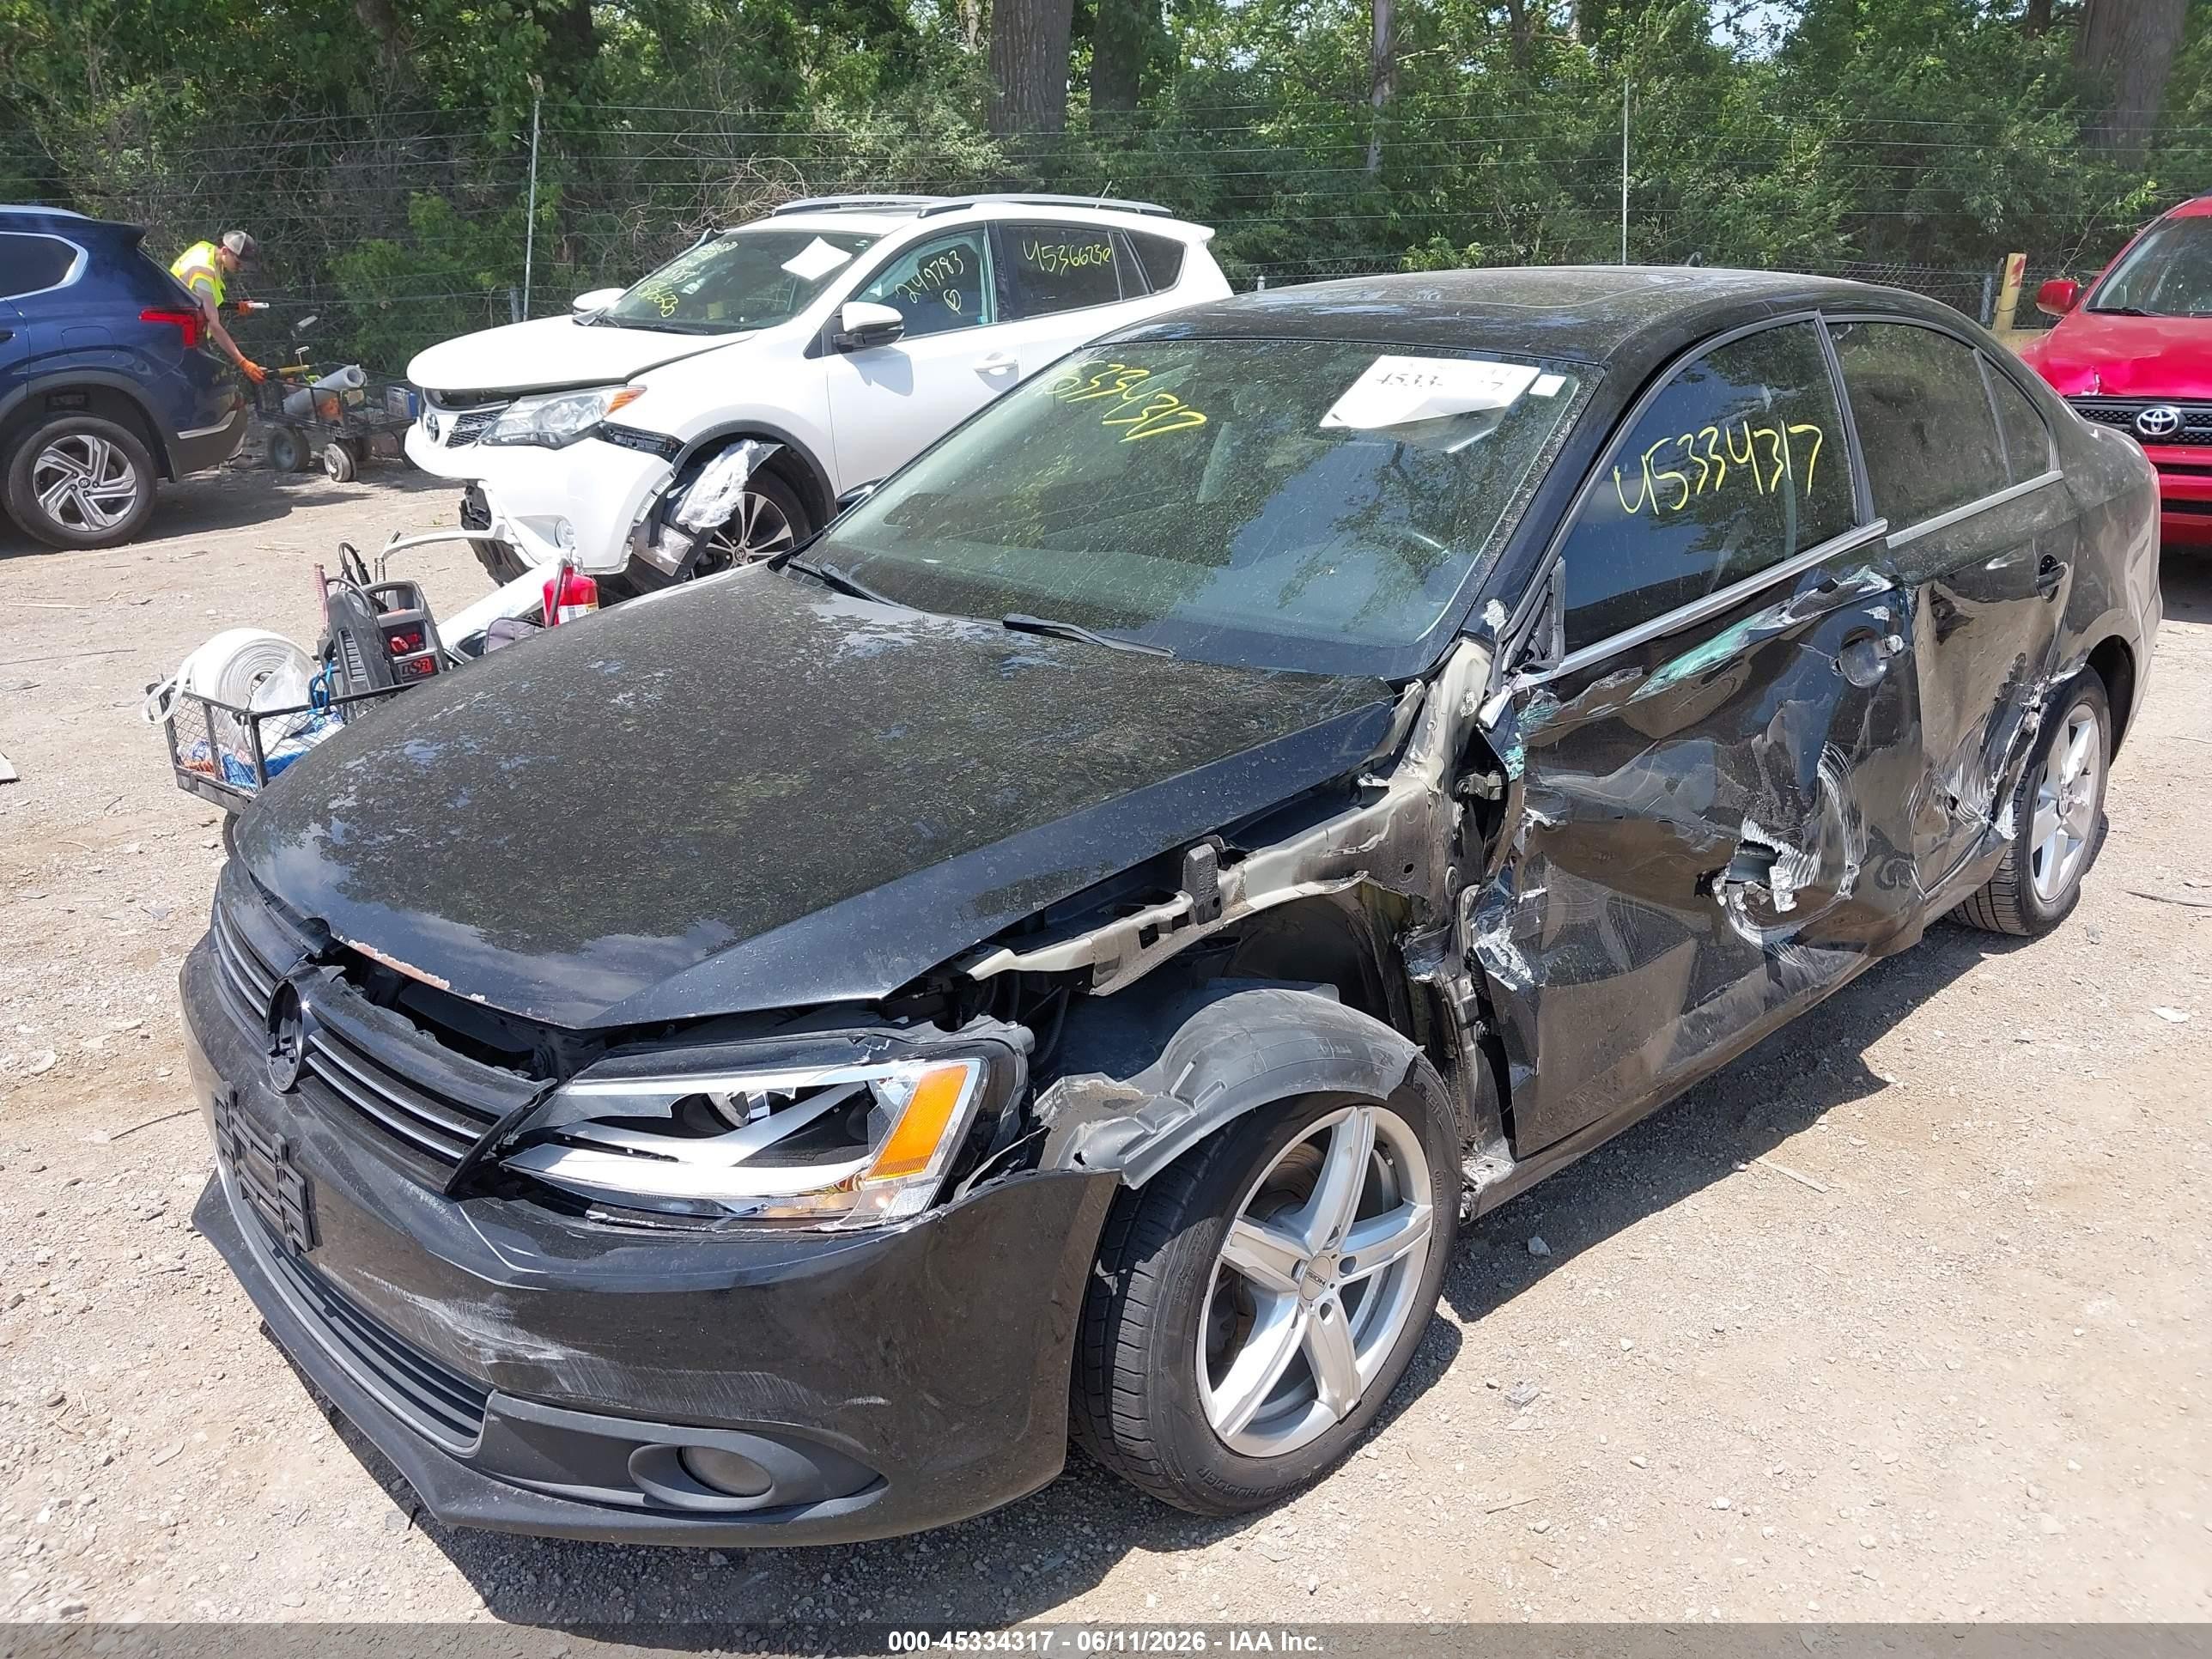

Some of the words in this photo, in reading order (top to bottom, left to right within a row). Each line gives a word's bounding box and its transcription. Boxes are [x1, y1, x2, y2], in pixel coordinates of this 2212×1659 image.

[895, 249, 964, 304] 249783
[1036, 359, 1208, 443] 5334317
[1613, 419, 1824, 516] 45334317
